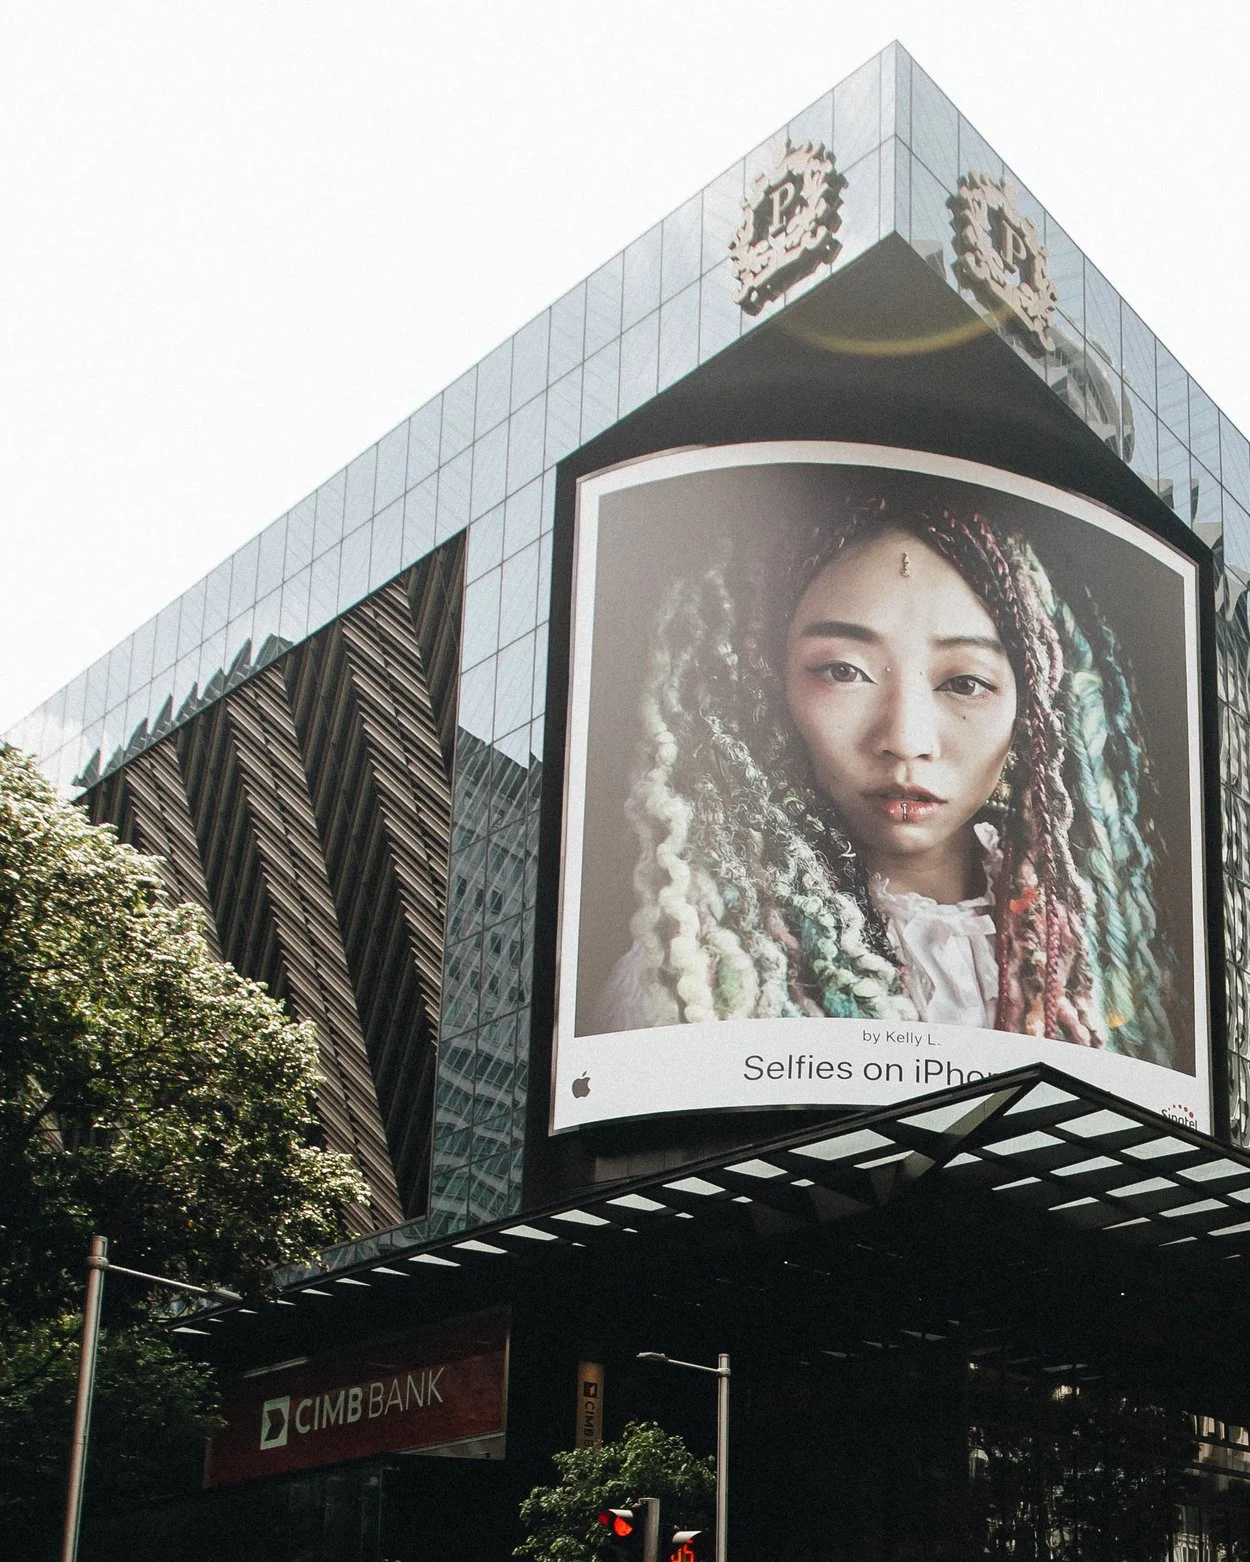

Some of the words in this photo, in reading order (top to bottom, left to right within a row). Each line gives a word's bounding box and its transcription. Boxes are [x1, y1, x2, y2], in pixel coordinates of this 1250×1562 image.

[862, 1030, 881, 1044] by
[886, 1031, 923, 1046] Kelly
[927, 1034, 941, 1046] L.
[743, 1054, 853, 1081] Selfies
[863, 1062, 903, 1082] on
[915, 1058, 1001, 1086] iPho
[295, 1387, 363, 1434] CIMB
[368, 1367, 446, 1418] BANK
[583, 1401, 596, 1437] CIMB
